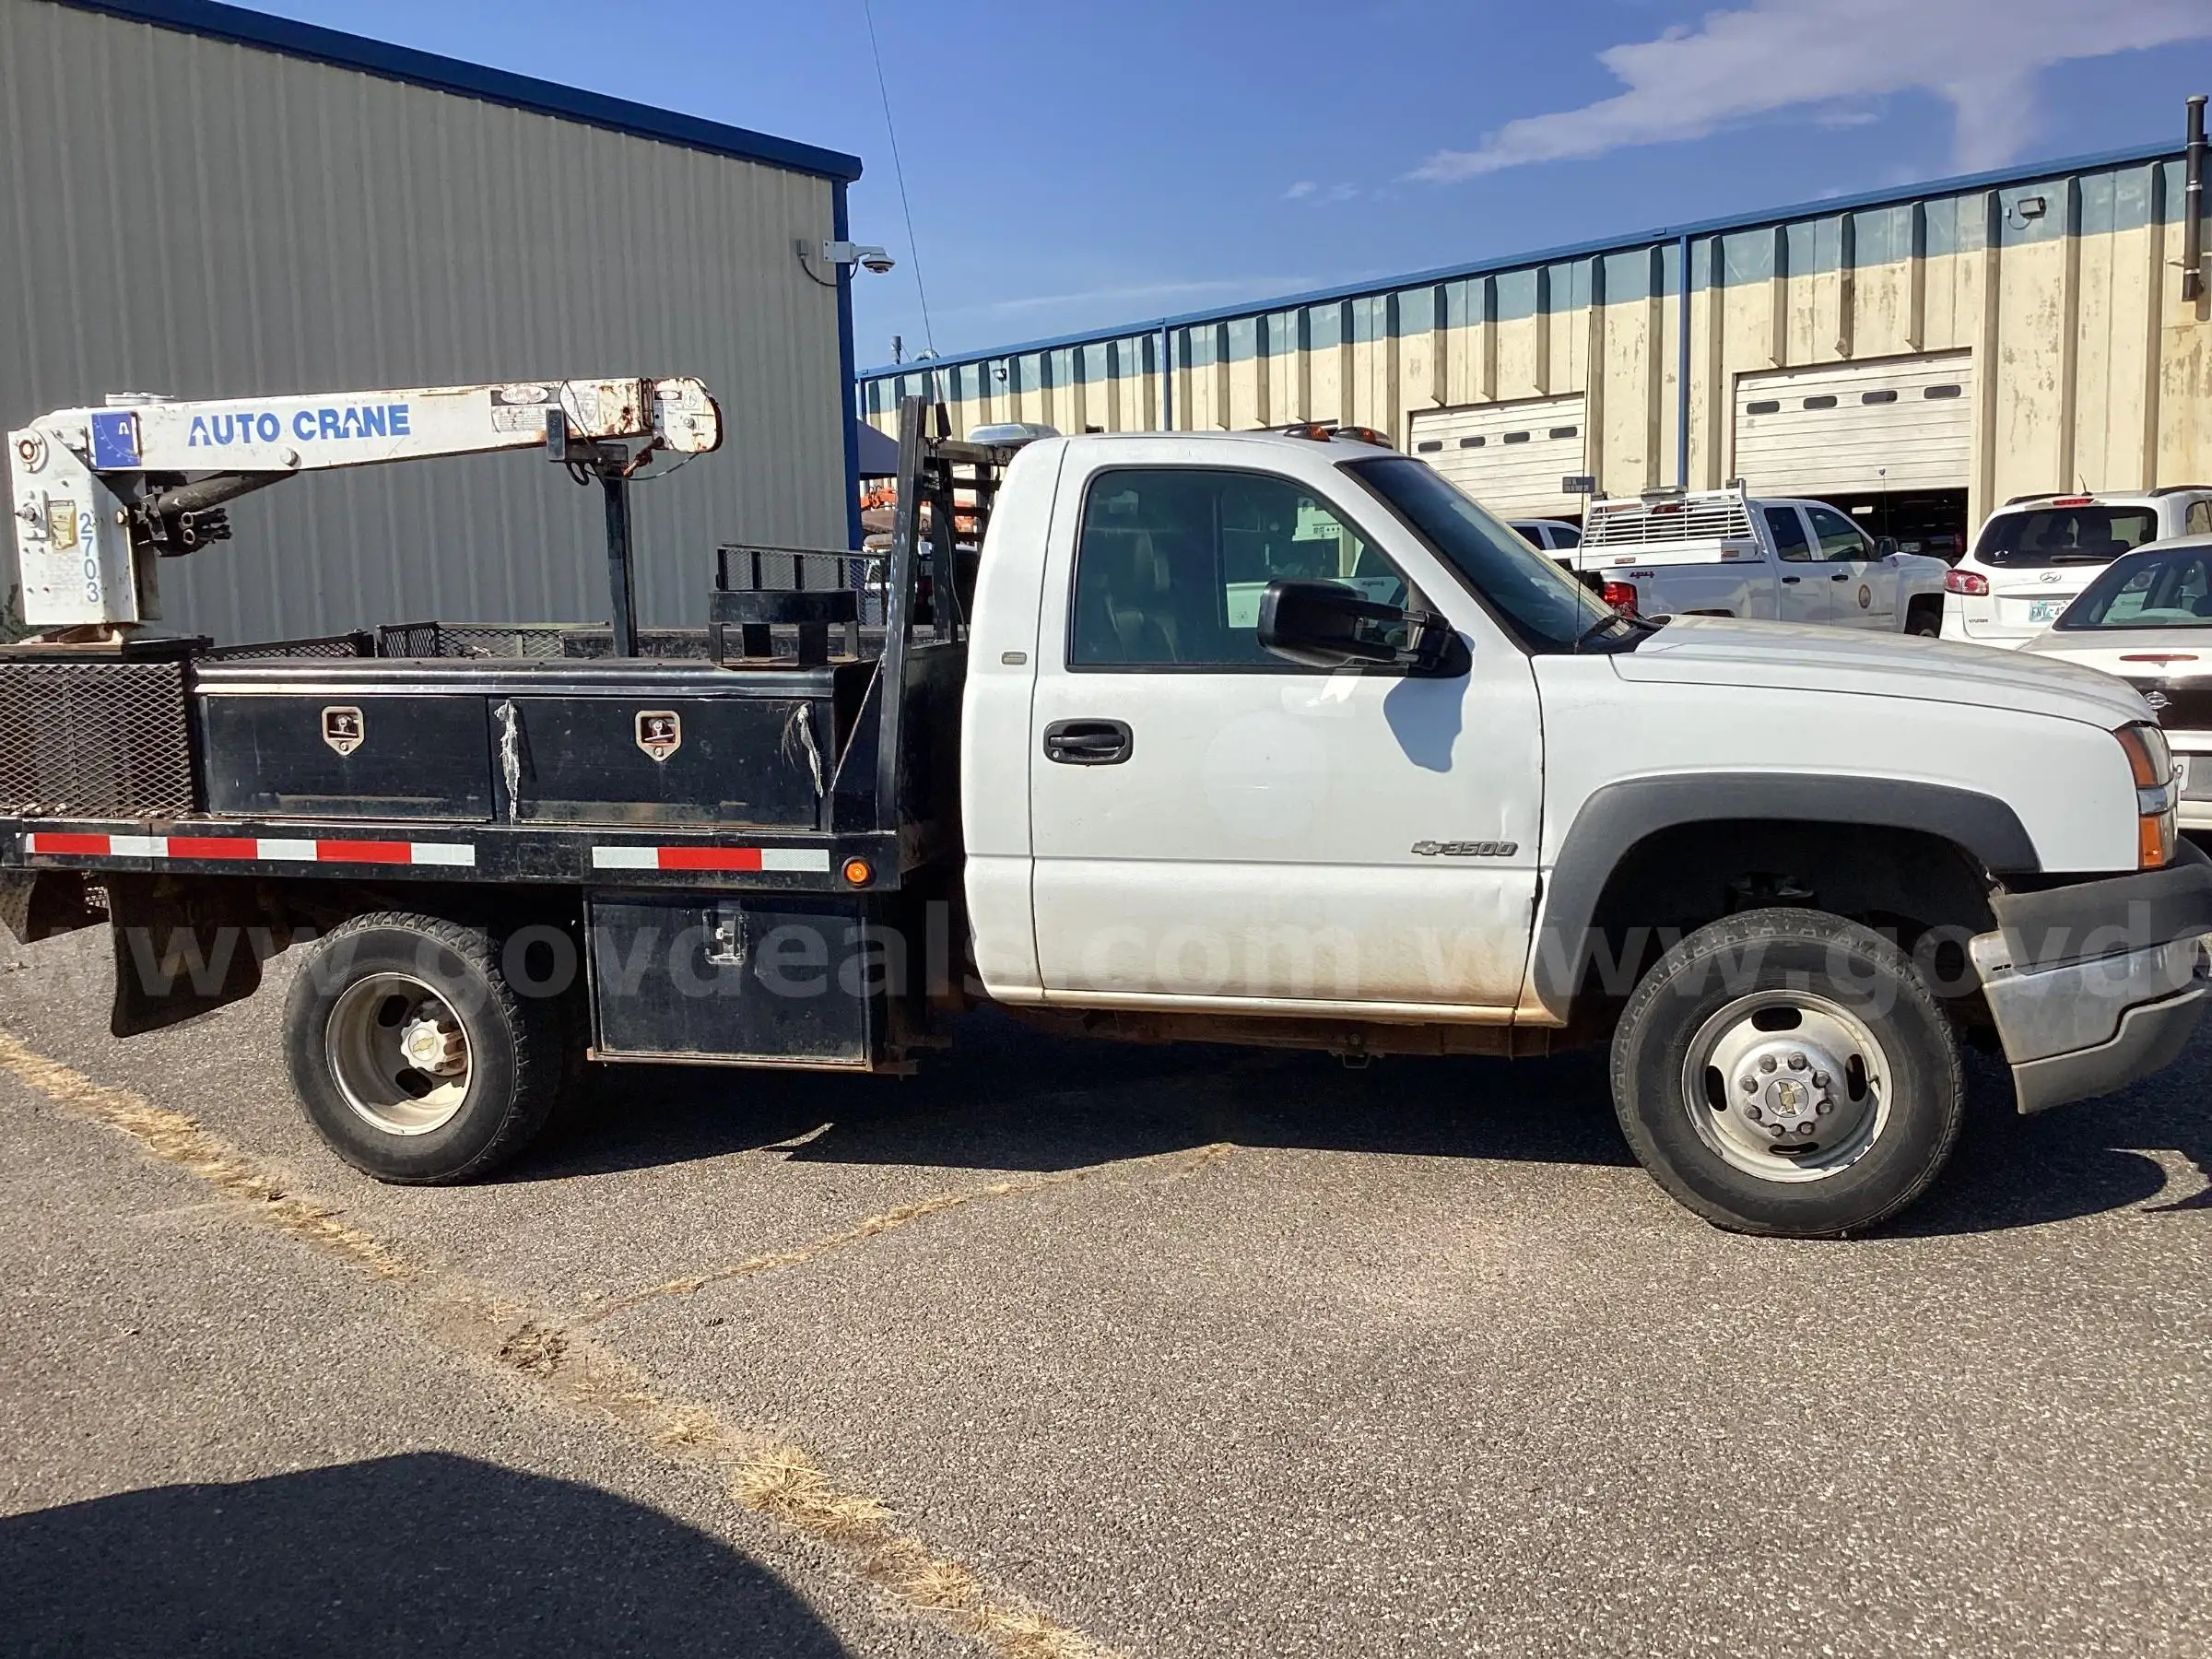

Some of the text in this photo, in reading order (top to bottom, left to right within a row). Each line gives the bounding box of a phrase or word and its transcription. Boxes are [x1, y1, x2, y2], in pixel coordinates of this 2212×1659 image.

[188, 404, 410, 447] AUTO CRANE
[79, 512, 100, 603] 2703
[1444, 841, 1519, 857] 3500
